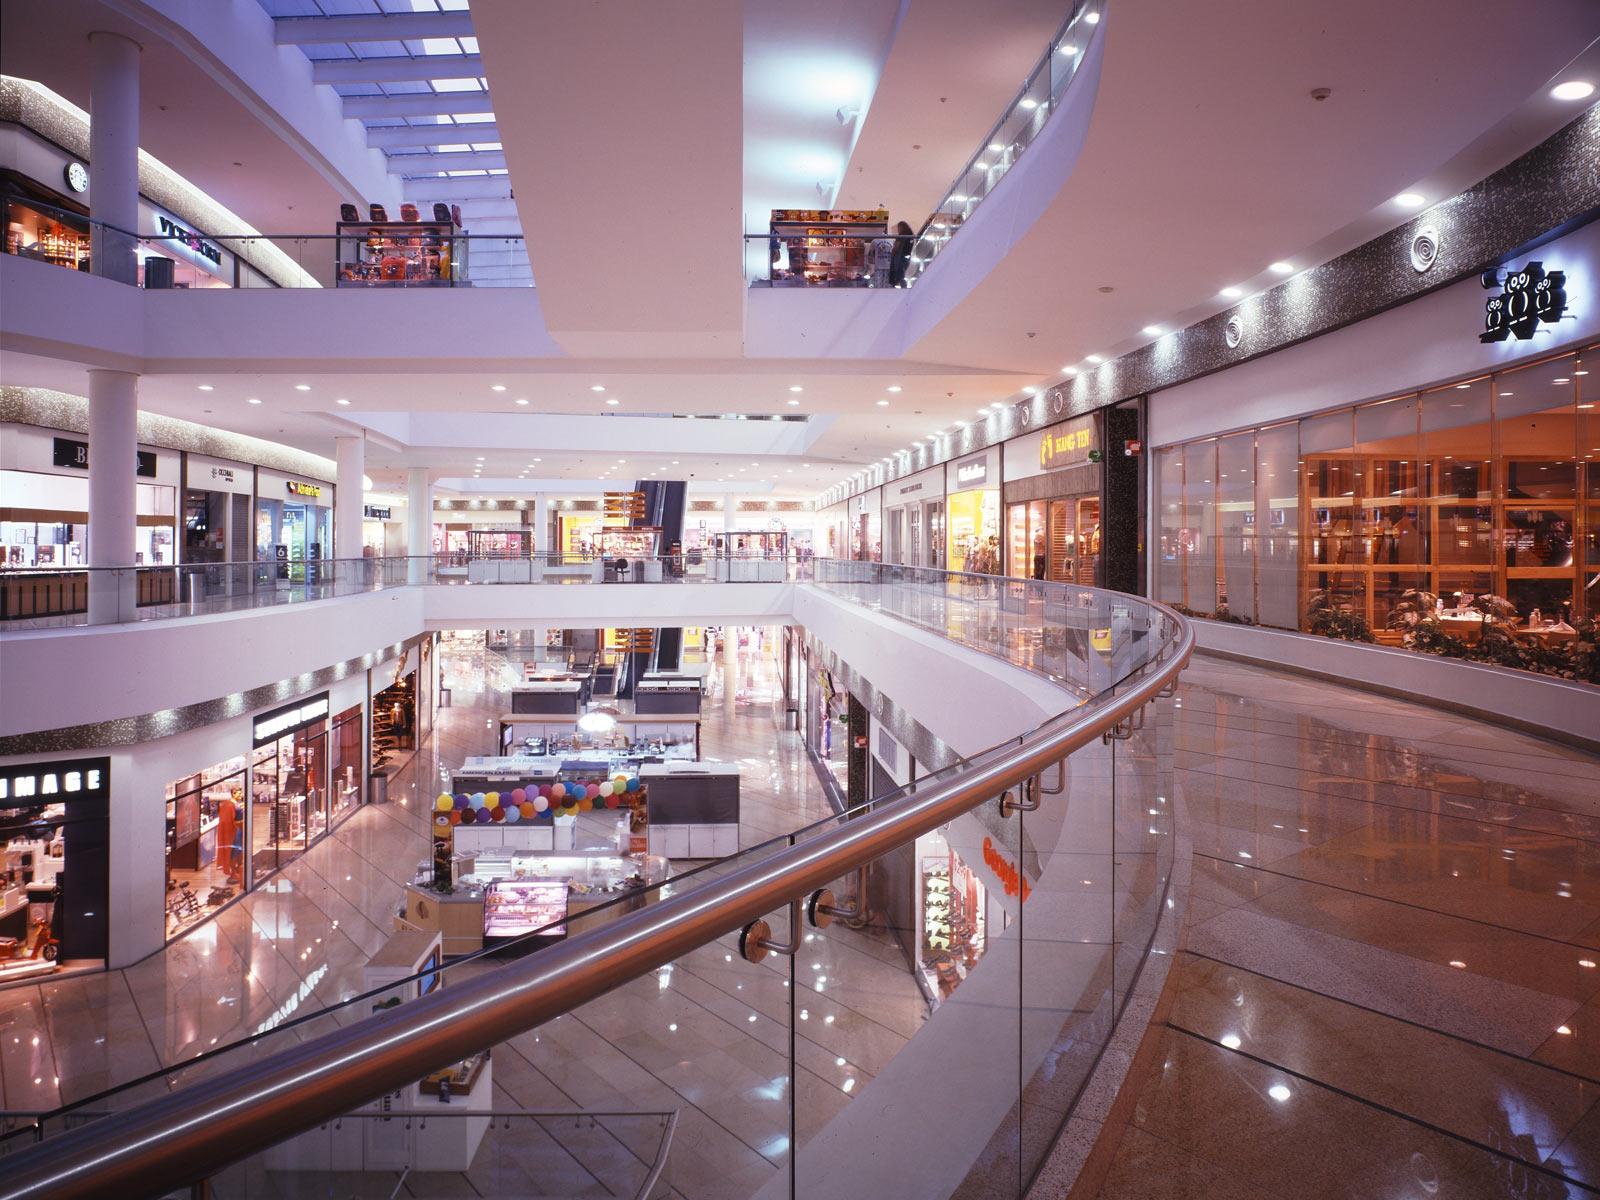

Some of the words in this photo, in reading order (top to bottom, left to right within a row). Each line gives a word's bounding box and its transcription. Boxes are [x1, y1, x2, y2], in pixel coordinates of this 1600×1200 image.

[1055, 433, 1076, 453] HANG
[1076, 428, 1090, 449] TEN
[277, 547, 285, 557] 6
